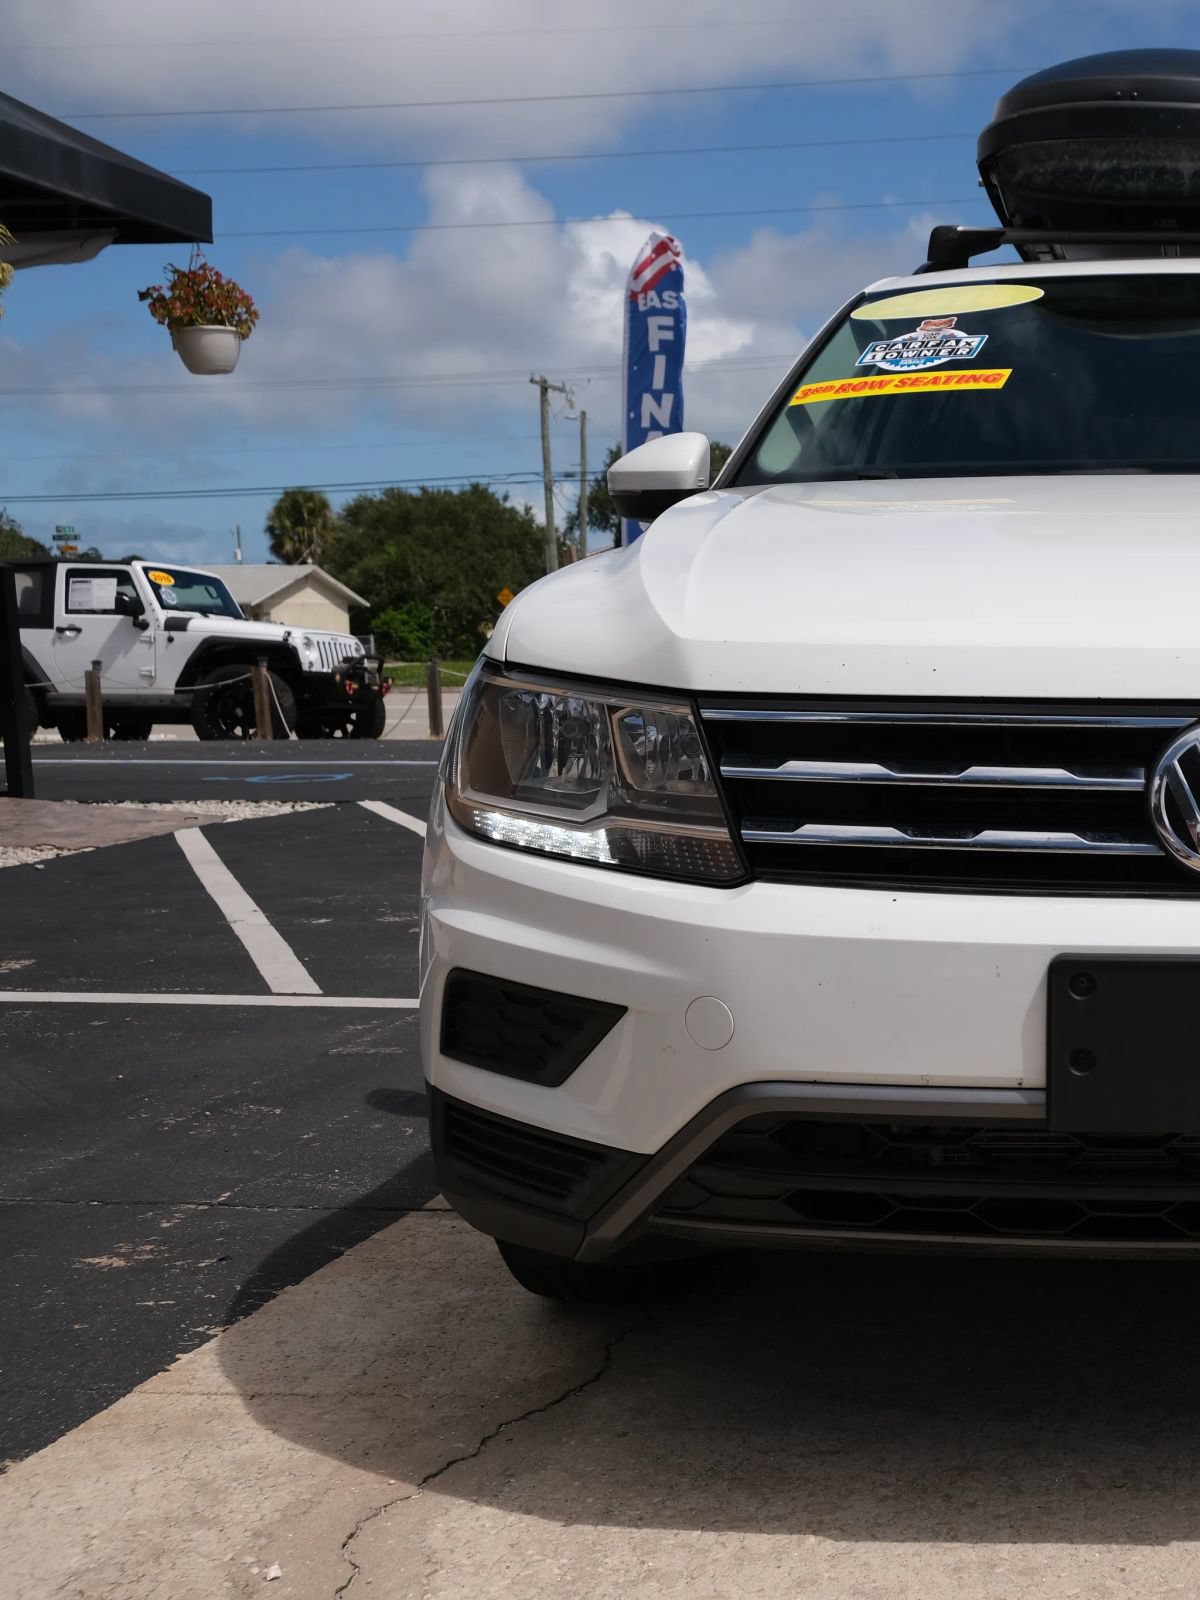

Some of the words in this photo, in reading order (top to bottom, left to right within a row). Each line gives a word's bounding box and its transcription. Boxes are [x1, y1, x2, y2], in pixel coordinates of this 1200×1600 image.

[637, 289, 685, 312] EAS
[873, 339, 977, 352] CARFAX
[833, 378, 895, 395] ROW
[893, 372, 1005, 389] SEATING
